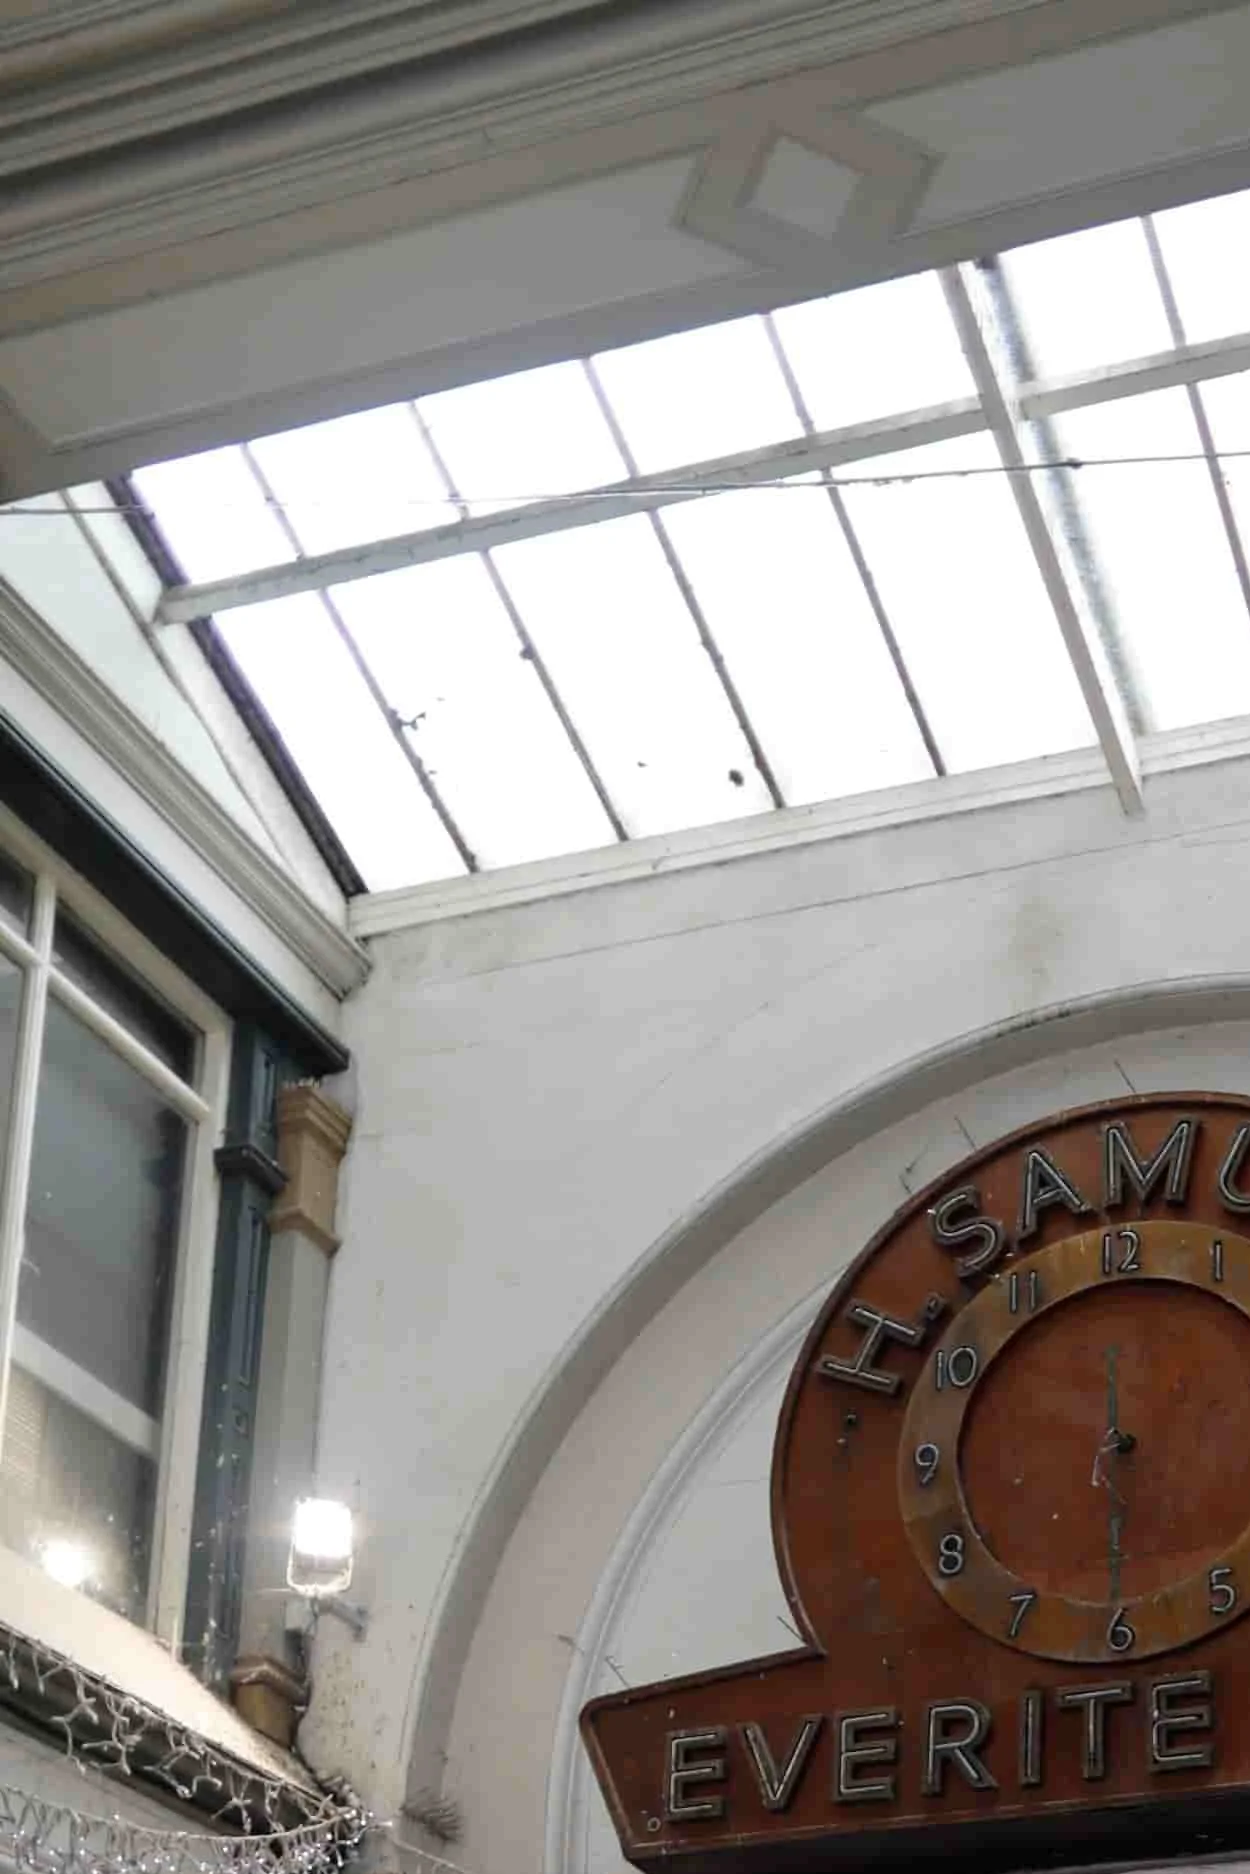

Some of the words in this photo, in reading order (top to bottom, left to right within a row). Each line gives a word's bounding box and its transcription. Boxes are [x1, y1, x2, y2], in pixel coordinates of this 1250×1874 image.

[1102, 1231, 1141, 1274] 12
[1209, 1240, 1225, 1281] 1
[1008, 1270, 1038, 1313] 11
[935, 1345, 977, 1390] 10
[913, 1442, 940, 1485] 9
[937, 1533, 965, 1576] 8
[1207, 1567, 1236, 1614] 5
[1008, 1593, 1036, 1637] 7
[1105, 1607, 1137, 1653] 6
[665, 1670, 1213, 1823] EVERITE
